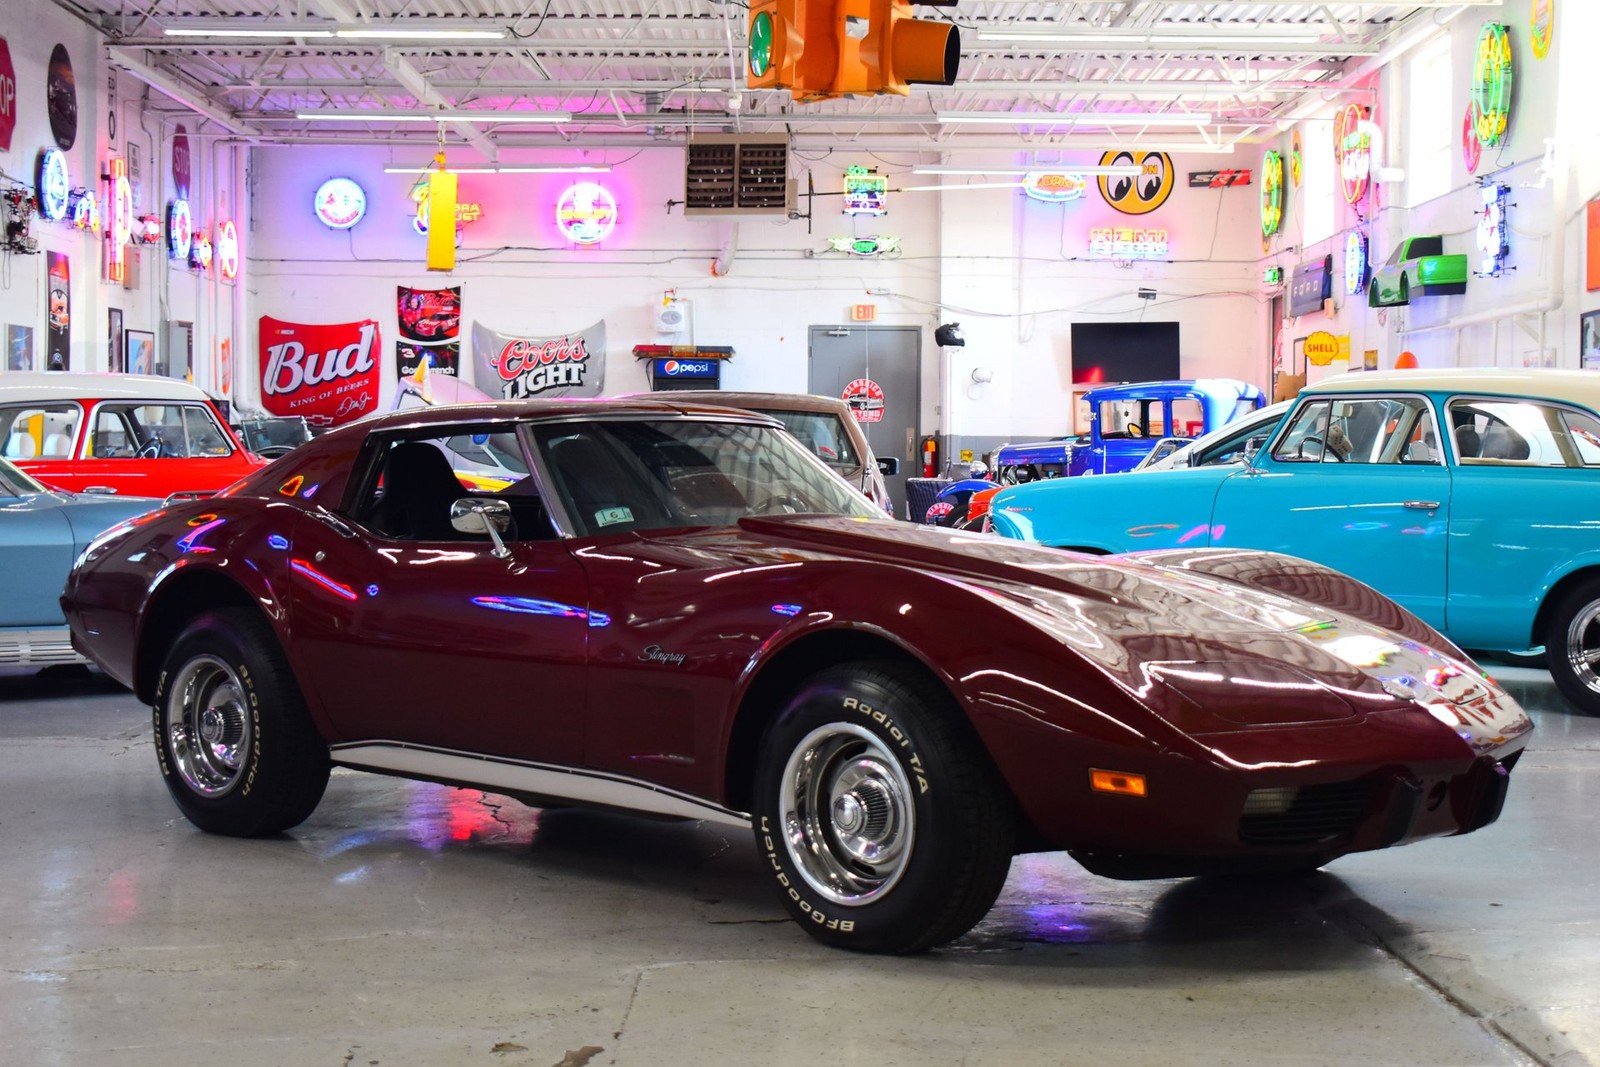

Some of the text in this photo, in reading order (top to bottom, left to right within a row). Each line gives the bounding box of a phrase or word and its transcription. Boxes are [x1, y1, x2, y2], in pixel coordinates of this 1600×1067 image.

[1191, 172, 1249, 184] SRT
[1293, 279, 1319, 297] FORD
[856, 304, 875, 320] EXIT
[401, 348, 415, 358] 3
[1307, 344, 1335, 353] SHELL
[263, 324, 375, 396] Bud
[490, 335, 589, 381] Coors
[680, 363, 708, 373] pepsi
[503, 362, 586, 401] LIGHT
[290, 378, 370, 408] KING OF BEERS
[853, 410, 881, 418] EYOND
[610, 511, 618, 519] 6
[637, 644, 686, 667] Stingray
[843, 697, 929, 794] Radial T/A
[761, 816, 855, 932] BFGoodrich
